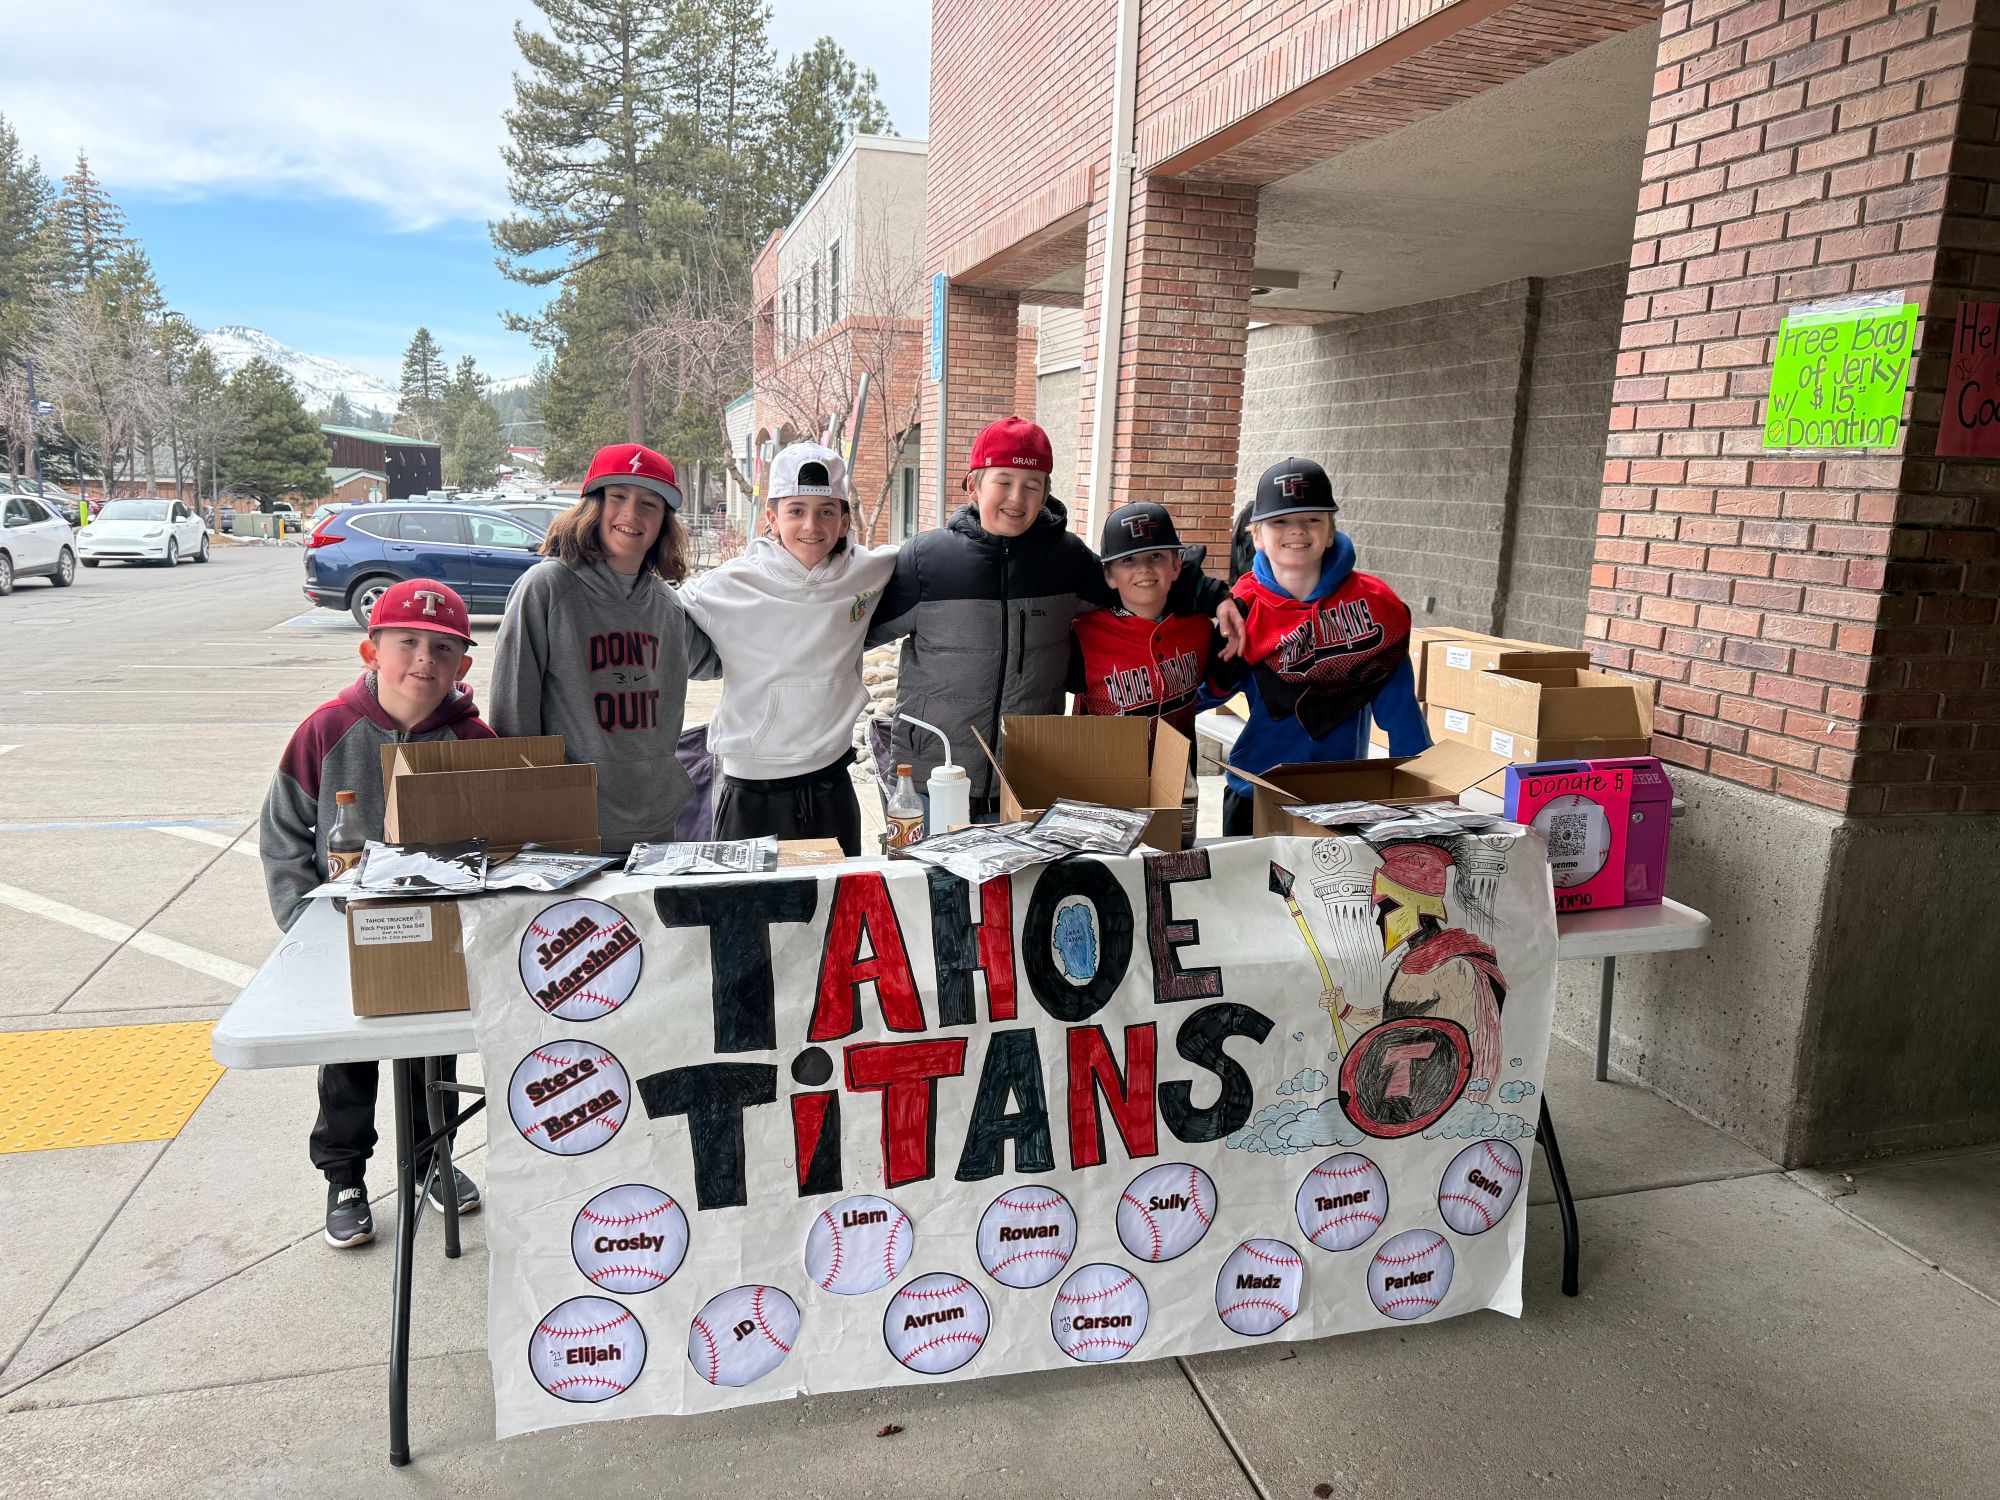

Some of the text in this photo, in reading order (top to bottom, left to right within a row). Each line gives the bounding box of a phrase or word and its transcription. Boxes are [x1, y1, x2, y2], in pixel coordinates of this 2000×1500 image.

[1780, 312, 1908, 357] Free Bag
[1799, 353, 1906, 393] of Jerky
[1786, 411, 1900, 446] Donation
[1012, 457, 1038, 466] GRANT
[413, 590, 445, 616] T
[1319, 599, 1374, 648] TITANS
[588, 631, 660, 673] DON'T
[1104, 664, 1153, 708] TAHOE
[594, 688, 660, 732] QUIT
[1529, 772, 1624, 797] Donate $
[1552, 861, 1578, 869] venmo
[536, 916, 599, 971] John
[654, 848, 1223, 1054] TAHOE
[536, 924, 641, 1012] Marshall
[525, 1058, 599, 1107] Steve
[1381, 1042, 1438, 1099] T
[541, 1089, 622, 1142] Bryan
[337, 1188, 361, 1204] NIKE
[1467, 1167, 1503, 1199] Gavin
[1148, 1194, 1190, 1212] Sully
[1315, 1189, 1371, 1212] Tanner
[842, 1207, 889, 1229] Liam
[594, 1233, 665, 1255] Crosby
[1000, 1222, 1060, 1242] Rowan
[1236, 1273, 1281, 1290] Madz
[1384, 1268, 1434, 1291] Parker
[732, 1318, 755, 1343] JD
[903, 1304, 965, 1332] Avrum
[1072, 1315, 1132, 1330] Carson
[566, 1344, 621, 1366] Elijah
